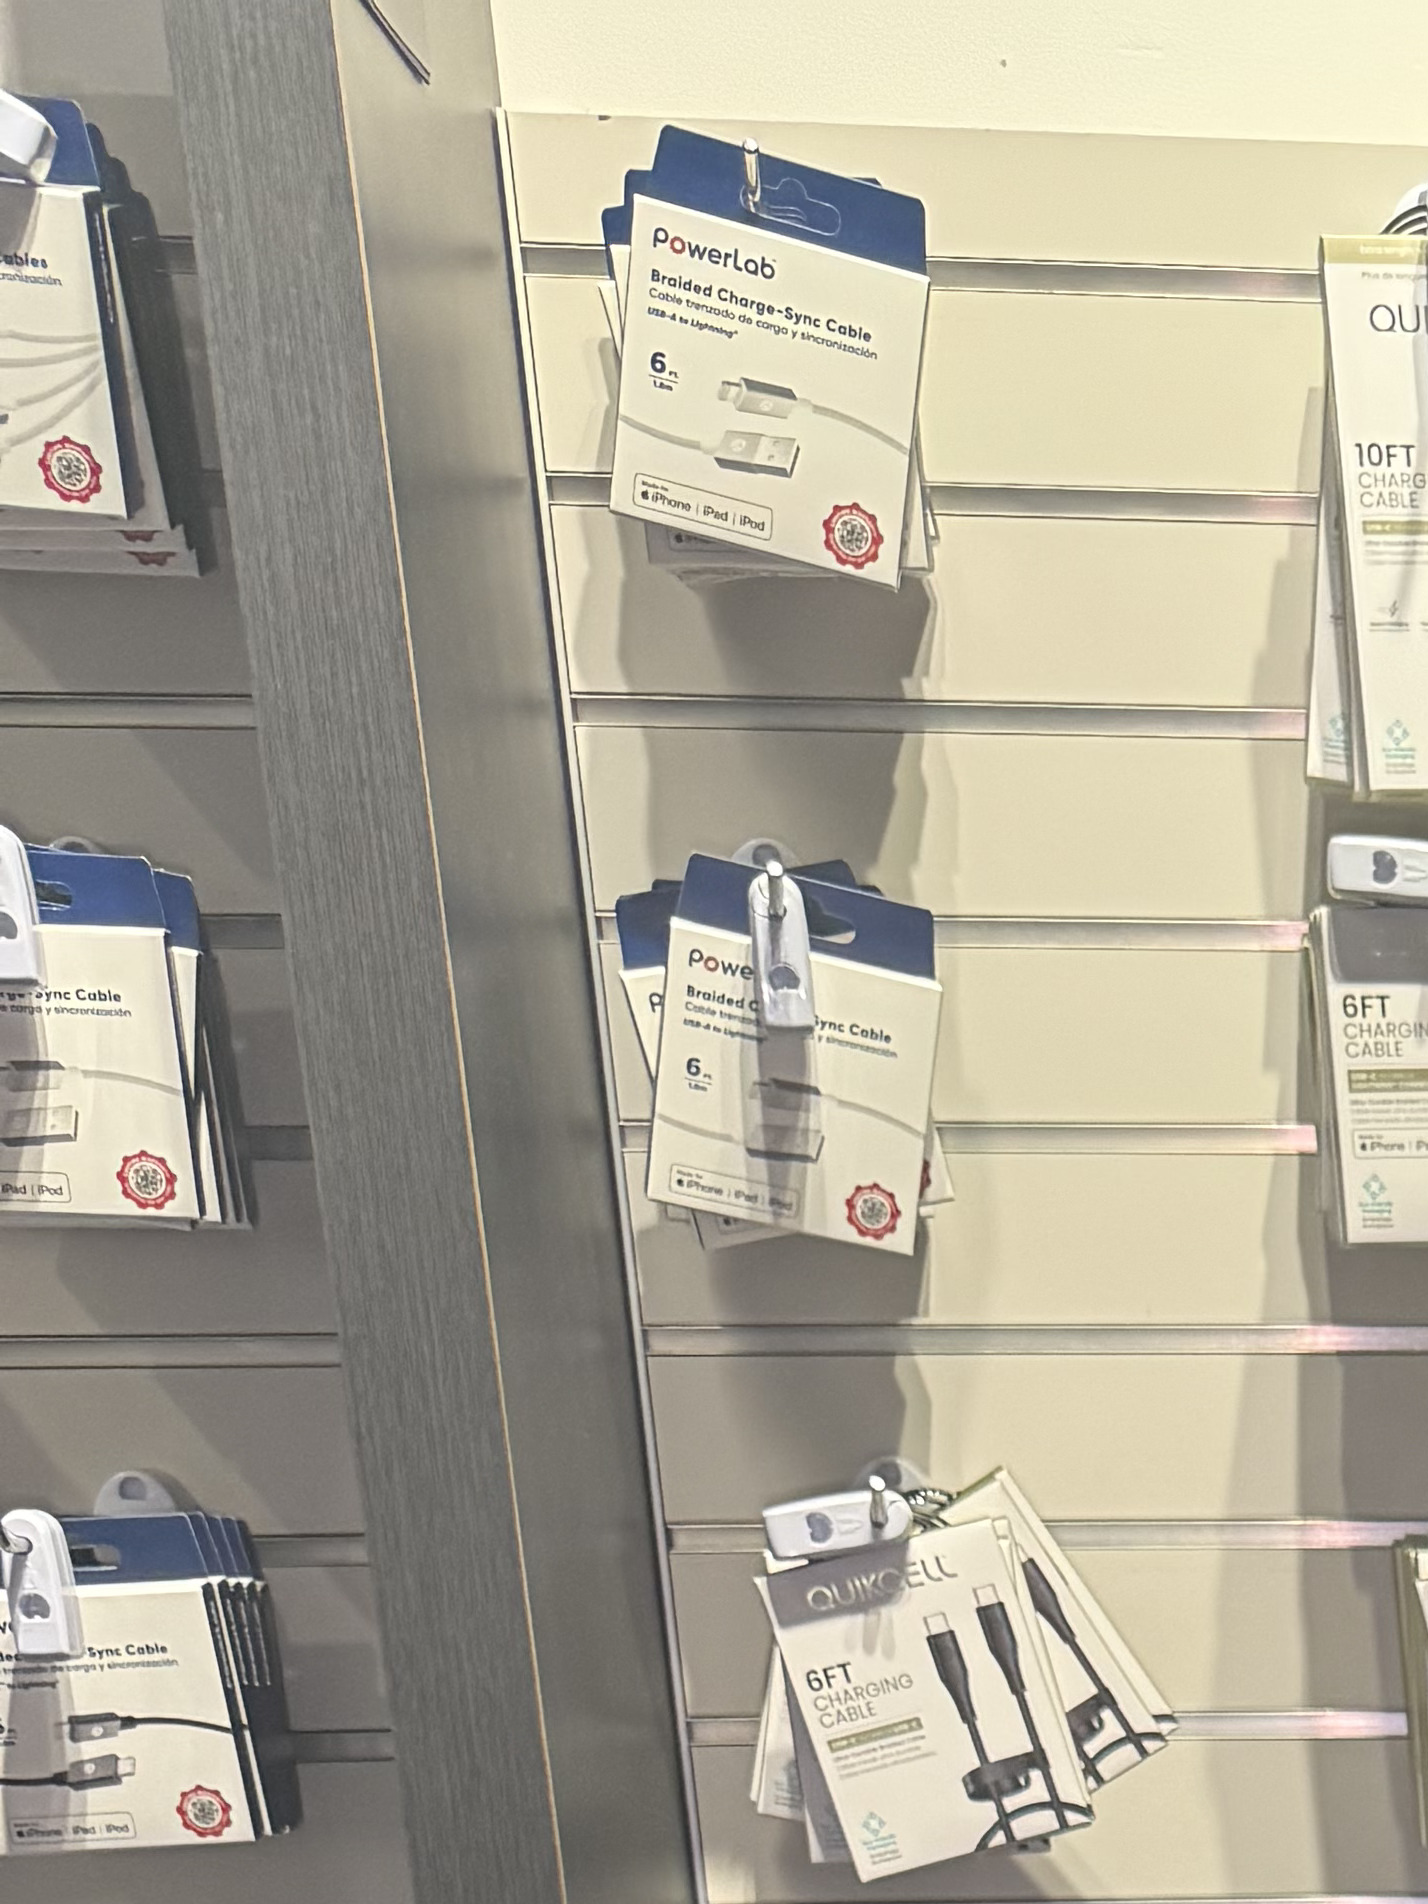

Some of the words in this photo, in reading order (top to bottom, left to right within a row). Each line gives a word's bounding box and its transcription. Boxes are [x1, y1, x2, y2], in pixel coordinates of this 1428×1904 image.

[0, 252, 48, 270] ables
[652, 227, 775, 280] PowerLab
[650, 269, 713, 298] Braided
[717, 287, 821, 329] Charge-Sync
[825, 319, 873, 344] Cable
[650, 351, 667, 374] 6
[1355, 443, 1416, 468] 10FT
[651, 492, 691, 512] iPhone
[702, 505, 729, 523] iPad
[739, 514, 765, 532] iPod
[1360, 492, 1420, 509] CABLE
[688, 949, 754, 981] Powe
[75, 989, 122, 1003] Cable
[686, 984, 745, 1010] Braided
[1342, 995, 1391, 1019] 6FT
[849, 1022, 892, 1044] Cable
[1345, 1040, 1404, 1059] CABLE
[686, 1057, 701, 1077] 6
[1369, 1139, 1406, 1152] iPhone
[686, 1179, 724, 1197] iPhone
[806, 1554, 959, 1611] QUIKCELL
[125, 1643, 168, 1656] Cable
[806, 1661, 853, 1693] 6FT
[813, 1673, 914, 1713] CHARGING
[818, 1703, 877, 1729] CABLE
